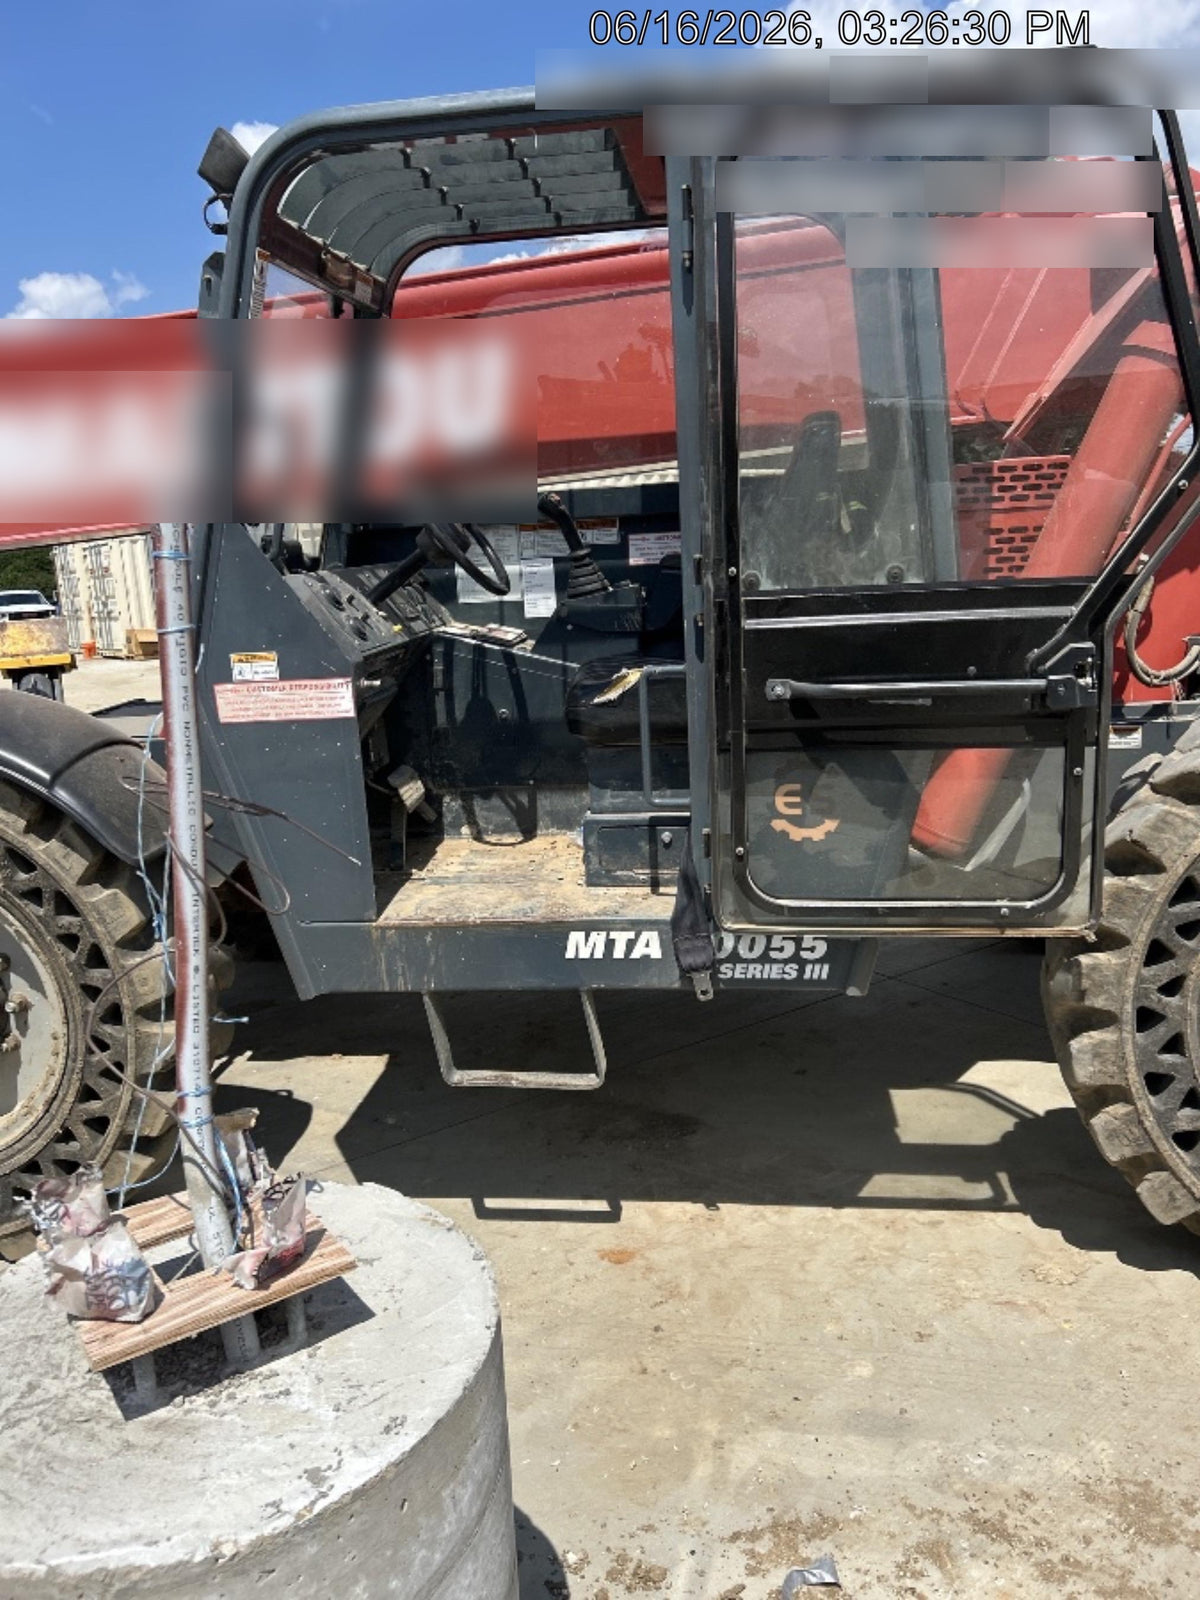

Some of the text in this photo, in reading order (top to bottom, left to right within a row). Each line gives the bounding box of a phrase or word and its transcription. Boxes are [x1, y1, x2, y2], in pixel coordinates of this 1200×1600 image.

[182, 686, 191, 712] PVC
[184, 721, 196, 816] NONMETALLIC
[564, 931, 662, 959] MTA
[718, 963, 830, 979] SERIES III
[193, 986, 201, 1034] LISTED
